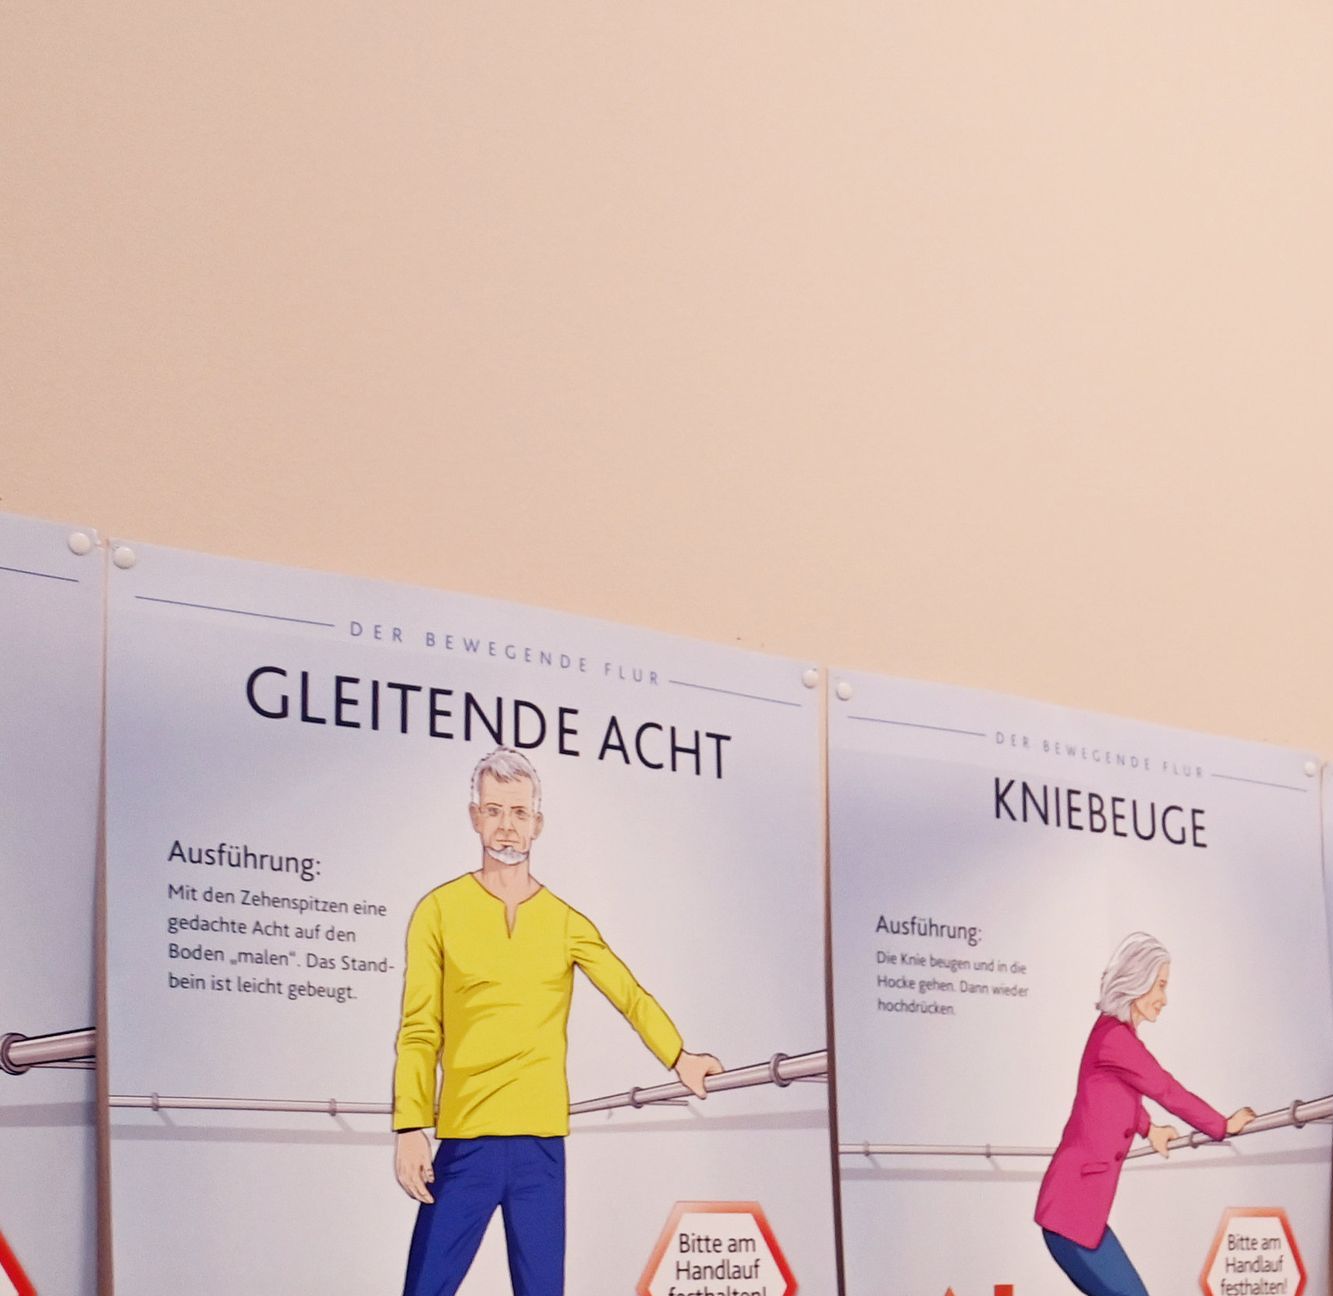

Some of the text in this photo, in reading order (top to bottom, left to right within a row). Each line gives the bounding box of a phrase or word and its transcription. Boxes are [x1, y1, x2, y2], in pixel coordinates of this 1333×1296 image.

[350, 621, 658, 685] DER BEWEGENDE FLUR
[245, 665, 732, 779] GLEITENDE ACHT
[996, 732, 1203, 778] DER BEWEGENDE FLUR
[995, 777, 1207, 848] KNIEBEUGE
[168, 840, 321, 881] Ausführung:
[168, 884, 387, 916] Mit den Zehenspitzen eine
[168, 915, 356, 942] gedachte Acht auf den
[876, 915, 982, 946] Ausführung:
[168, 943, 224, 961] Boden
[306, 953, 335, 969] Das
[342, 956, 395, 973] Stand-
[877, 951, 1026, 974] Die Knie beugen und in die
[168, 972, 357, 1003] bein ist leicht gebeugt.
[877, 975, 915, 989] Hocke
[960, 980, 988, 994] Dann
[992, 985, 1029, 997] wieder
[679, 1233, 756, 1253] Bitte am
[1227, 1234, 1281, 1250] Bitte am
[676, 1258, 760, 1280] Handlauf
[1226, 1255, 1284, 1273] Handlauf
[1221, 1278, 1287, 1296] festhalten!
